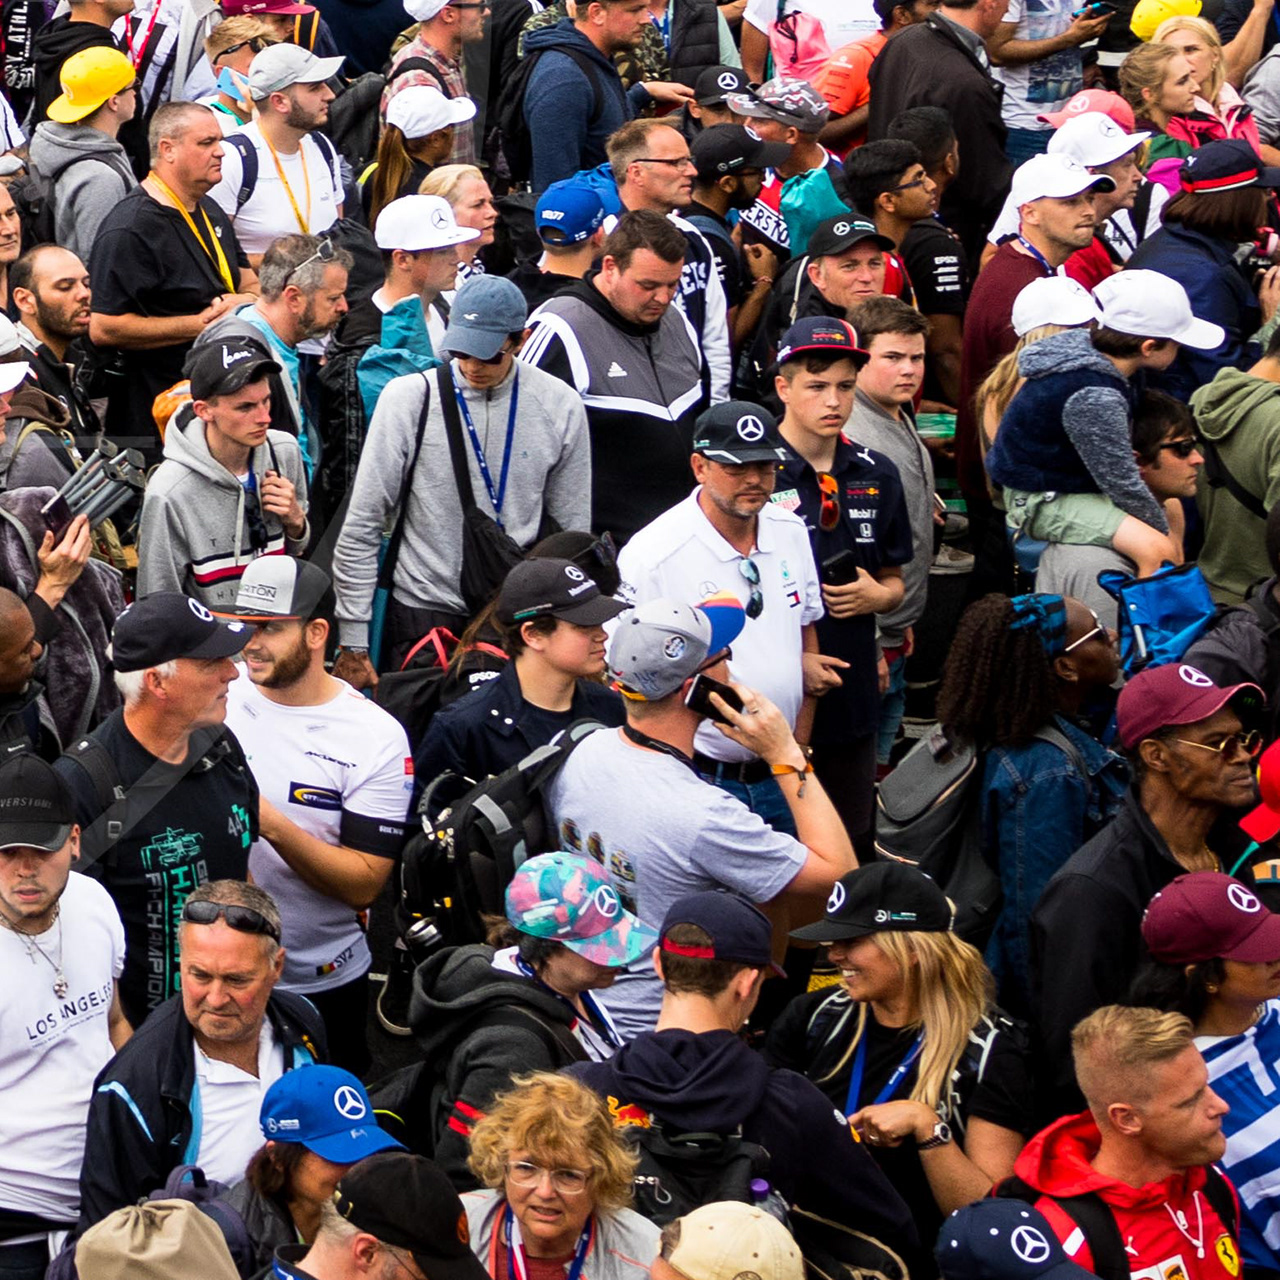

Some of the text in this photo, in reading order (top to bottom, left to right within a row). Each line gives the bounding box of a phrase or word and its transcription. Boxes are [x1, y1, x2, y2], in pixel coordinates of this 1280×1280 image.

[227, 813, 244, 837] 44
[144, 871, 165, 1010] F1-CHAMPION
[334, 948, 354, 969] SV2
[25, 1012, 58, 1042] LOS
